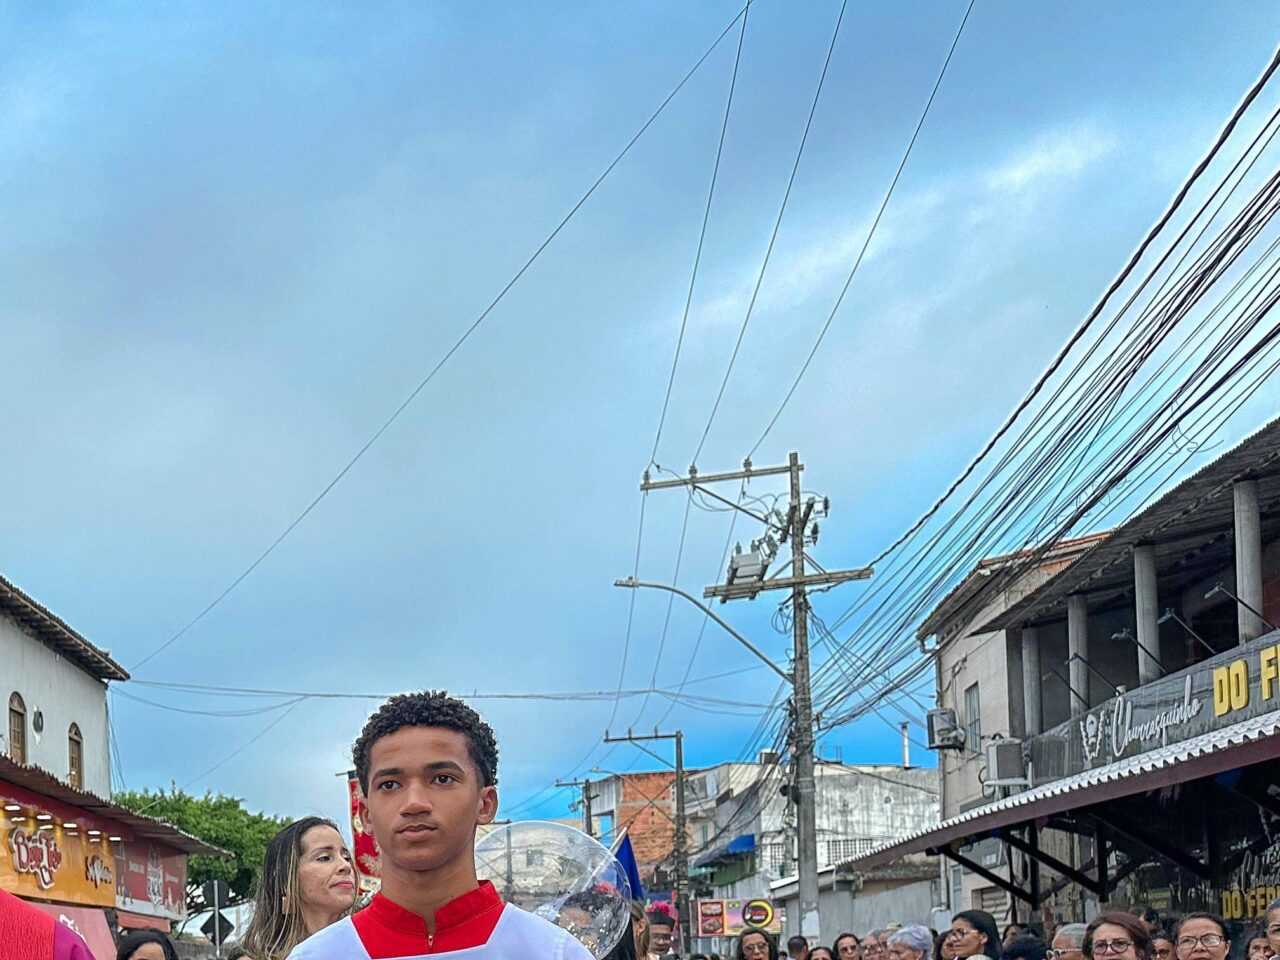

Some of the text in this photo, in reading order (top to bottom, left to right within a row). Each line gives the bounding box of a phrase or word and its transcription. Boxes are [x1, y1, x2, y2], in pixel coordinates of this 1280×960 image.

[1212, 659, 1249, 718] DO
[1259, 643, 1280, 702] F
[1222, 888, 1242, 920] DO
